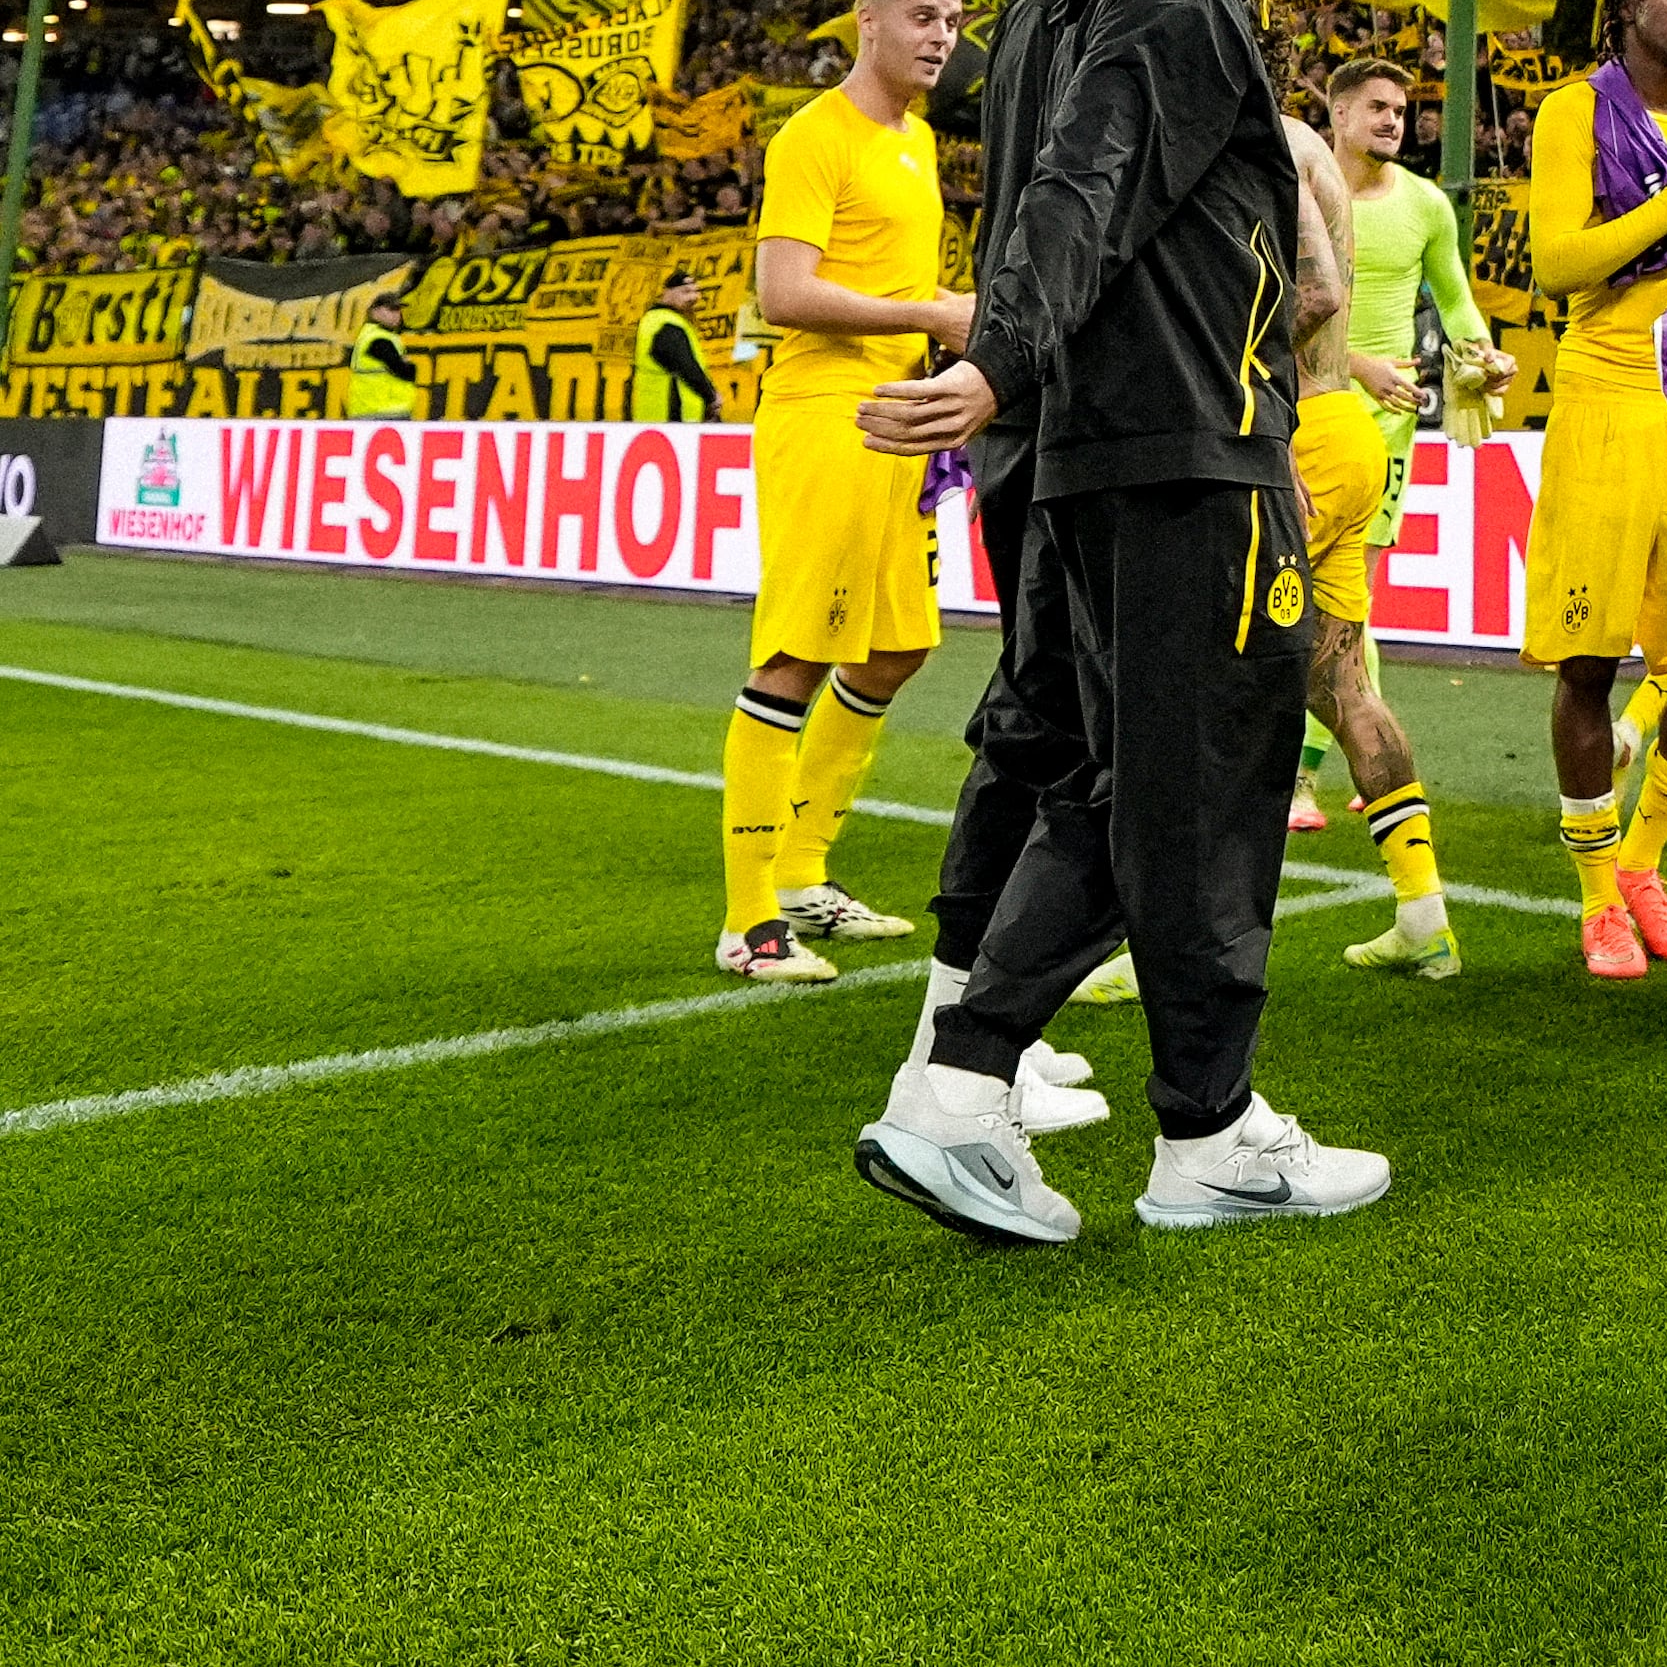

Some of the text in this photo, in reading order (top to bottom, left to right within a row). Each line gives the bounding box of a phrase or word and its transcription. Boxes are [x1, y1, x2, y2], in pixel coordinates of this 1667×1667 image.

[218, 427, 753, 580] WIESENHOF
[108, 508, 206, 542] WIESENHOF
[1271, 572, 1300, 612] BVB
